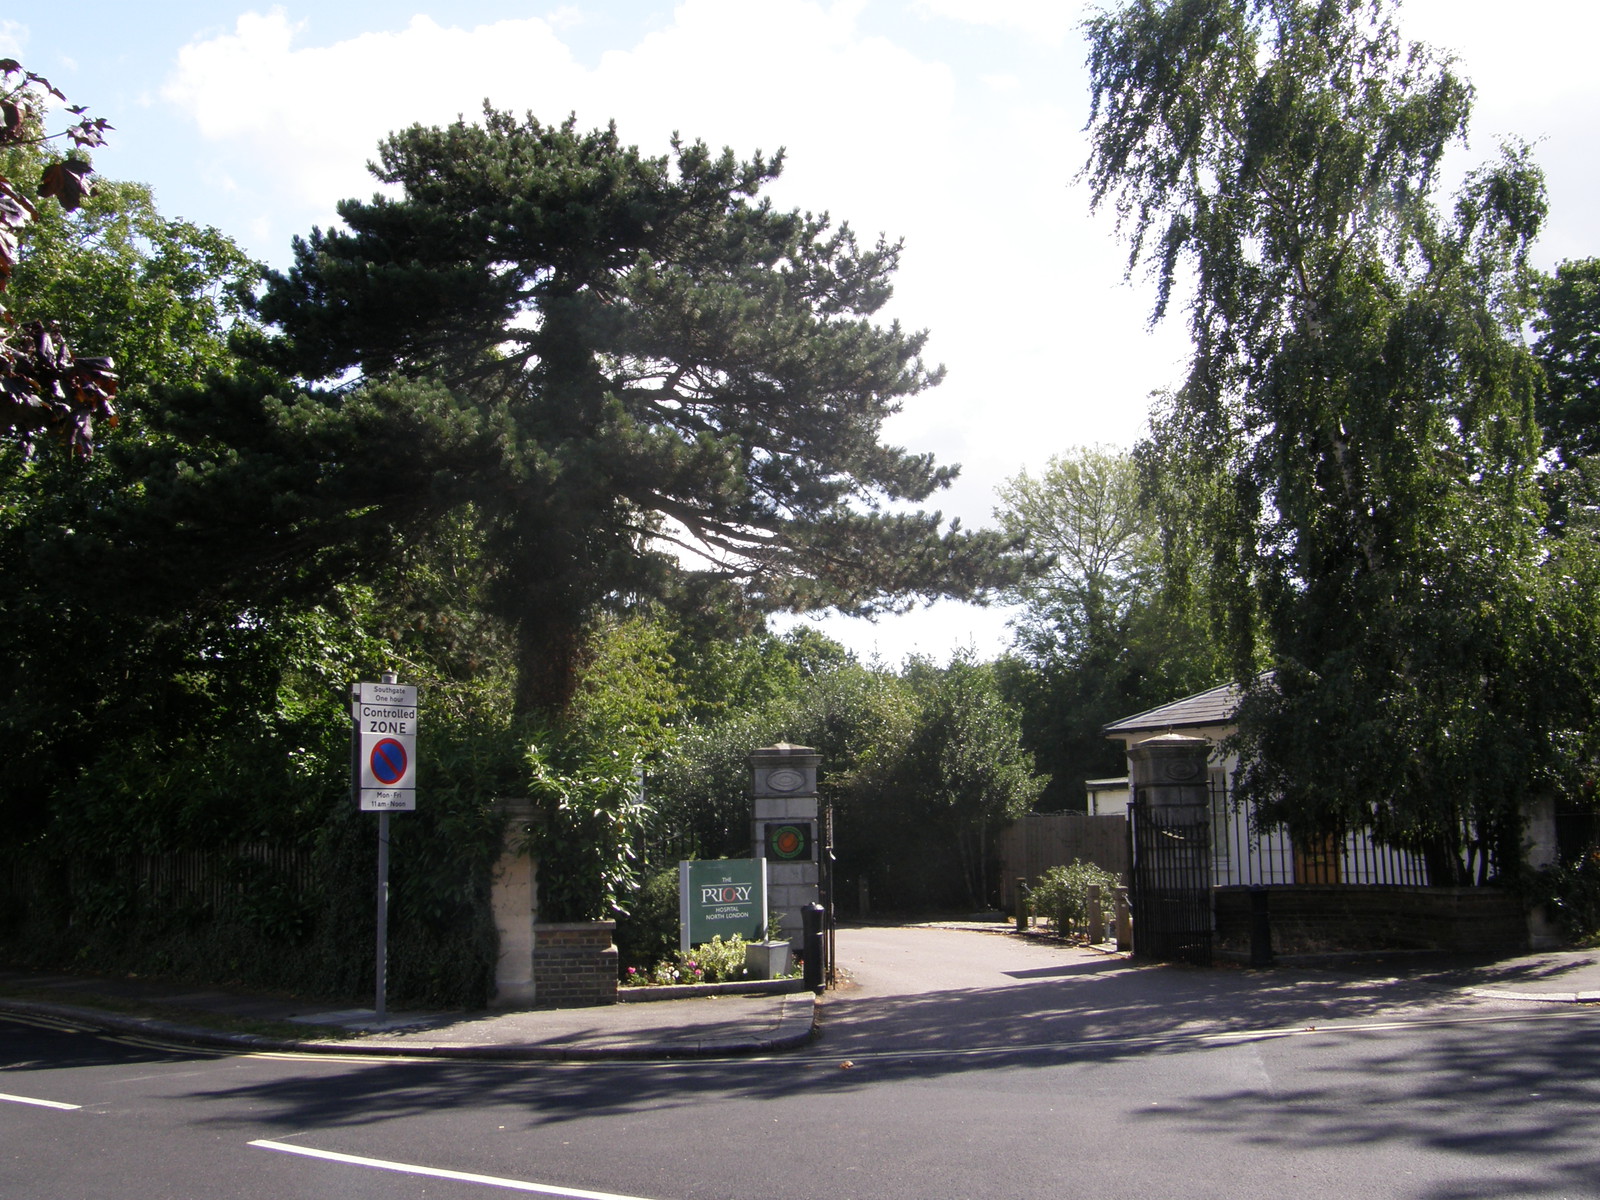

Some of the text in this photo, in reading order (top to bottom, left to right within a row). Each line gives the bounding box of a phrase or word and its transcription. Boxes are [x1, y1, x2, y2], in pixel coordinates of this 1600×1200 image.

[374, 686, 406, 694] Southgate
[364, 707, 414, 718] Controlled
[370, 721, 406, 734] ZONE
[701, 886, 752, 903] PRIORY
